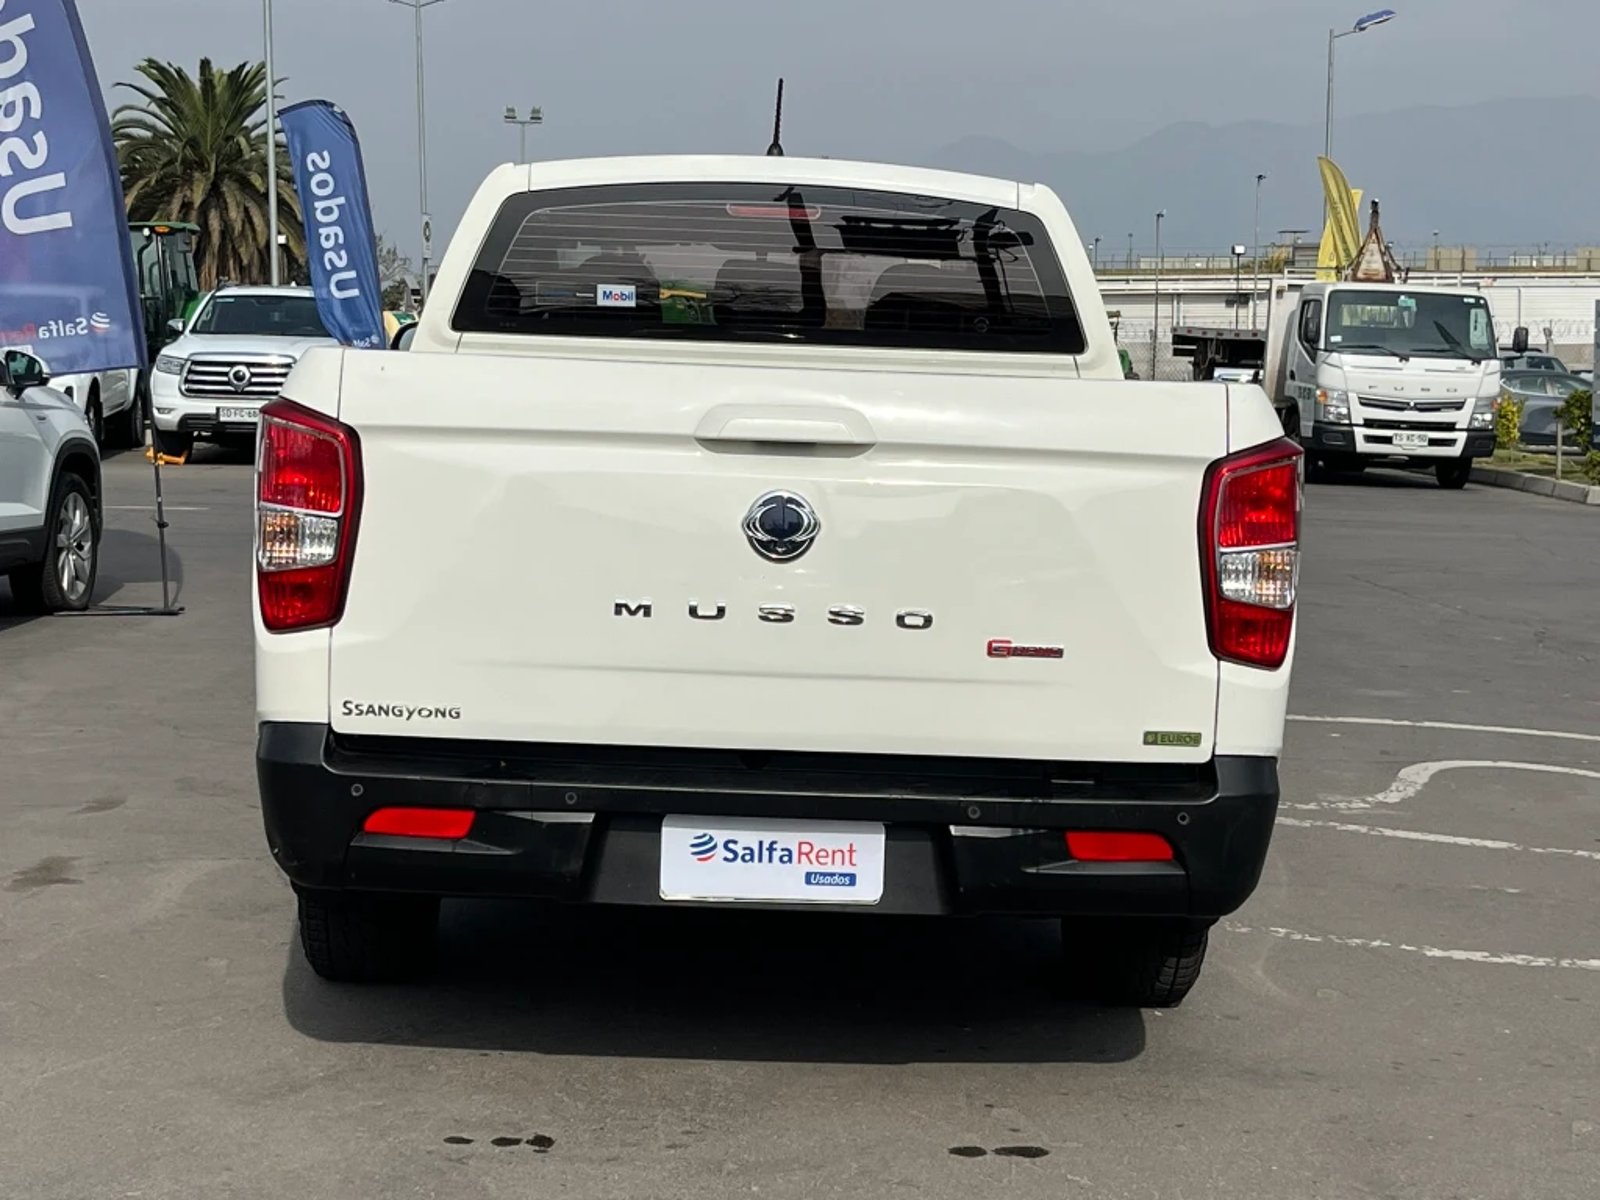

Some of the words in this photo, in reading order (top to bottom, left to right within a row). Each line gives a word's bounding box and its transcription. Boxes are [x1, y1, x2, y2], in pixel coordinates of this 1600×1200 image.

[602, 290, 634, 301] Mobil
[613, 597, 934, 630] MUSSO
[342, 699, 461, 721] SSANGYONG
[722, 838, 857, 867] SalfaRent
[810, 873, 851, 886] Usados
